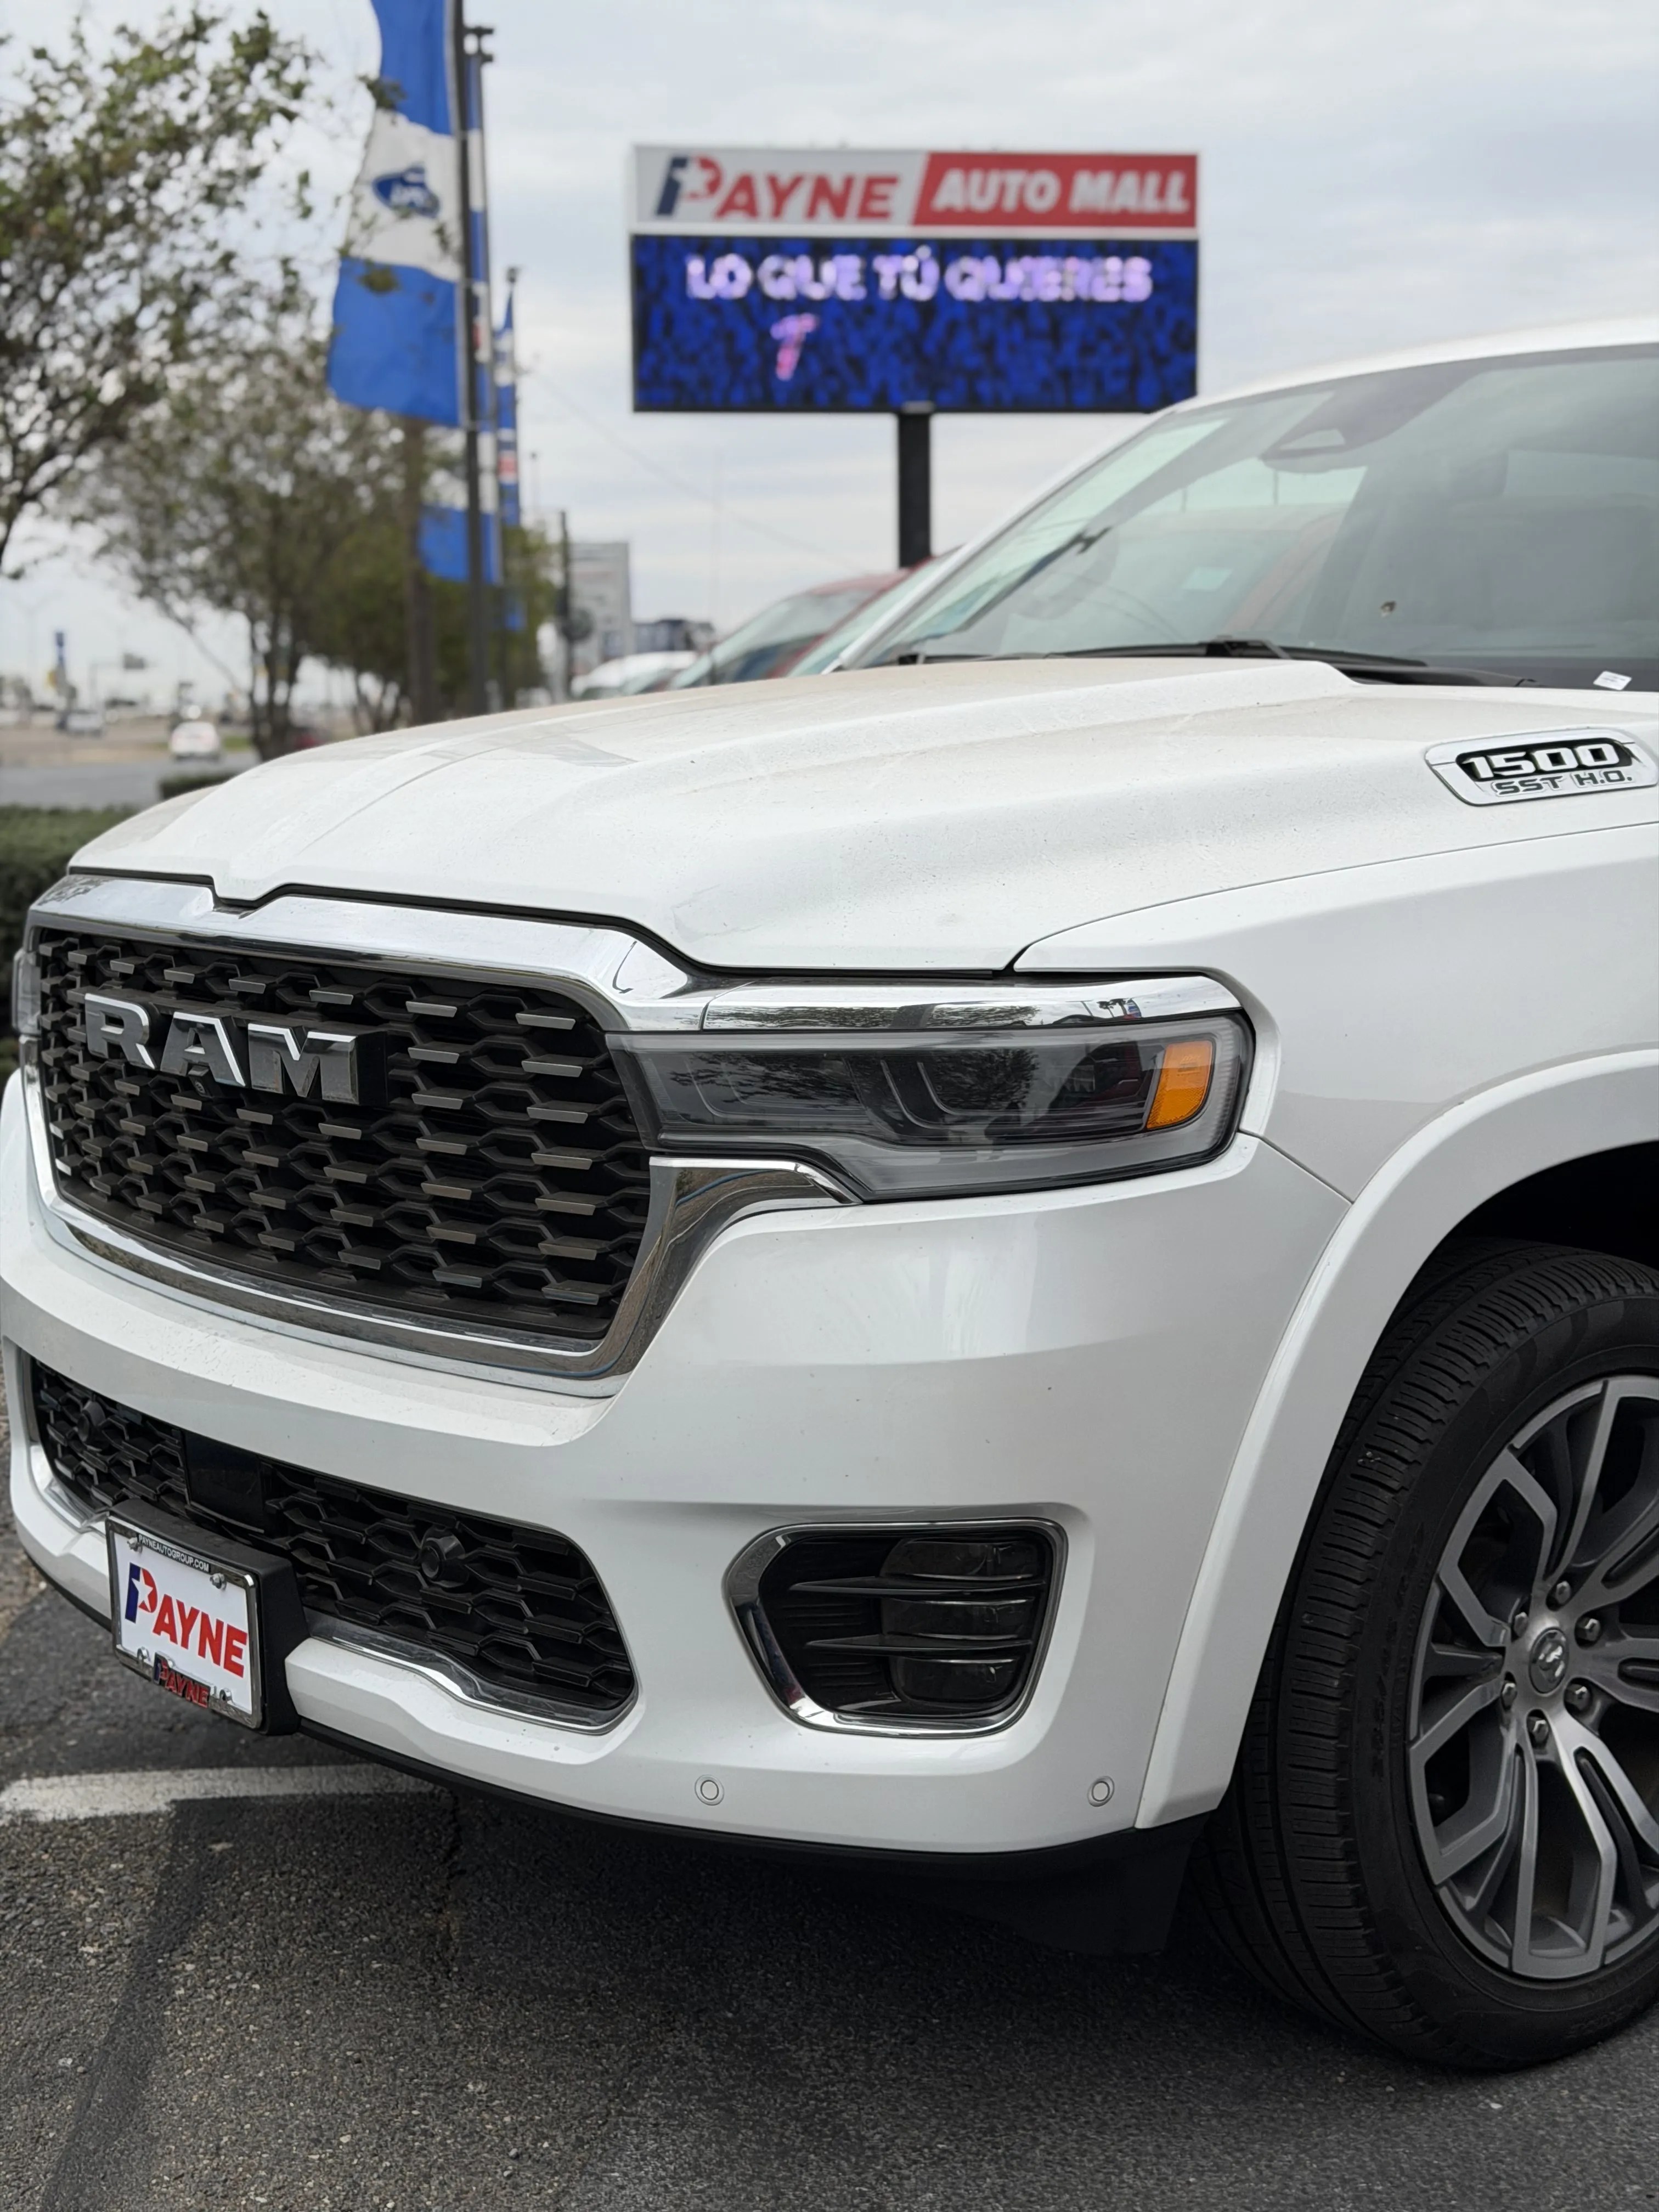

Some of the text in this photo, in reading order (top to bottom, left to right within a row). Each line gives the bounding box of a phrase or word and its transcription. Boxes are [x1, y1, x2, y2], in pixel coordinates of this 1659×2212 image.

[654, 155, 1190, 219] PAYNE AUTO MALL
[686, 245, 1153, 302] LO QUE TÚ QUIERES
[1462, 742, 1620, 779] 1500
[1494, 769, 1633, 795] SST H.O.
[84, 992, 360, 1105] RAM
[138, 1534, 210, 1573] PAYNEAUTOGROUP.COM
[125, 1562, 247, 1678] PAYNE
[153, 1656, 208, 1708] PAYNE
